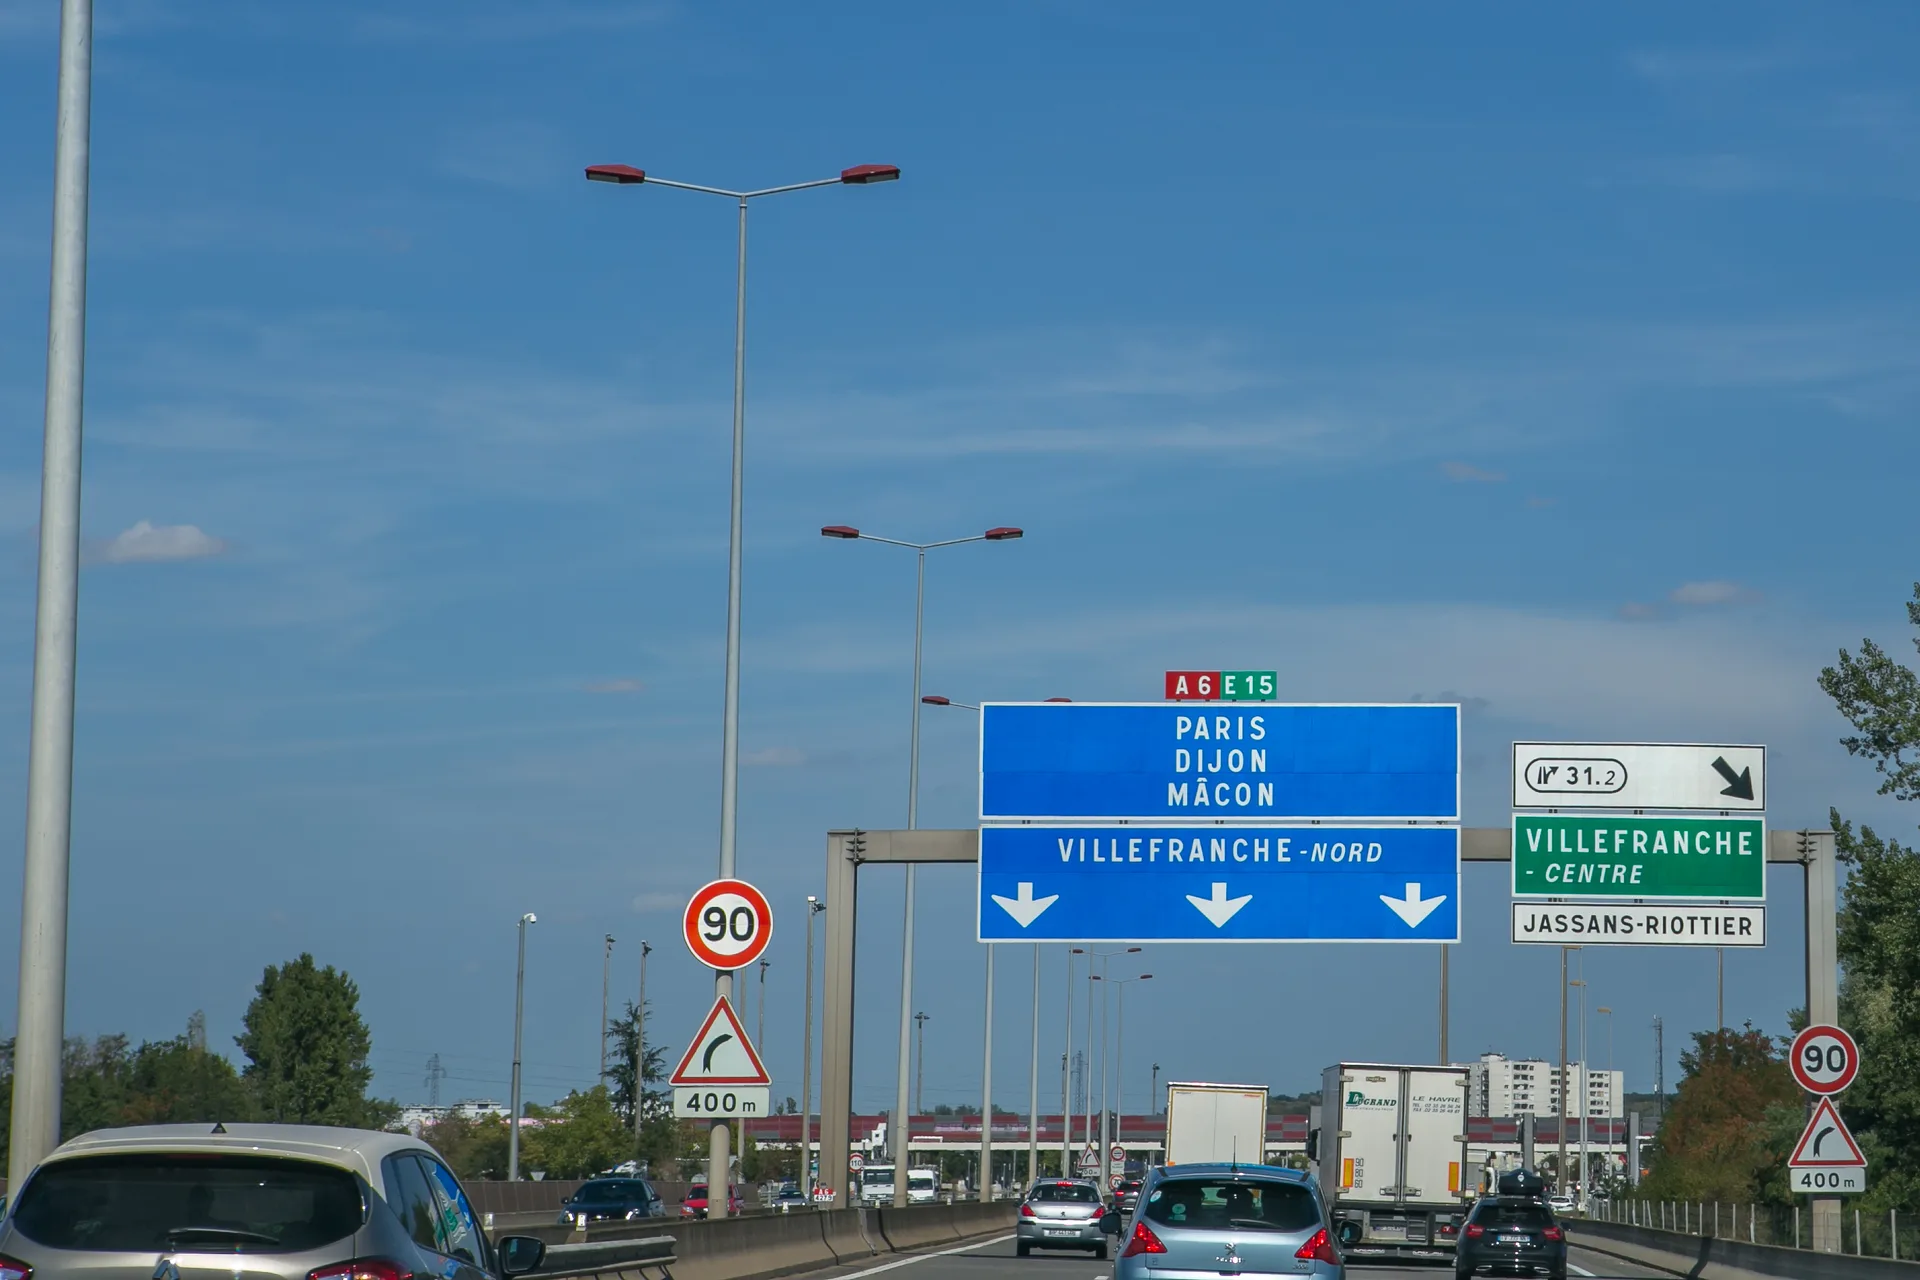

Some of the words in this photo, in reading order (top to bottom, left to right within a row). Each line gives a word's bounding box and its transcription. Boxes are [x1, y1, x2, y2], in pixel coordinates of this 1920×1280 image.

[1175, 675, 1189, 695] A
[1198, 675, 1211, 695] 6
[1225, 675, 1236, 695] E
[1245, 675, 1273, 695] 15
[1176, 716, 1266, 741] PARIS
[1175, 748, 1266, 773] DIJON
[1566, 766, 1616, 786] 31.2
[1168, 777, 1273, 807] MÂCON
[1525, 828, 1753, 856] VILLEFRANCHE
[1545, 863, 1644, 884] CENTRE
[703, 906, 755, 942] 90
[1523, 914, 1753, 936] JASSANS-RIOTTIER
[1804, 1045, 1846, 1073] 90
[686, 1092, 737, 1113] 400
[742, 1099, 756, 1112] m
[1428, 1096, 1461, 1104] HAVRE
[1800, 1172, 1840, 1188] 400
[1843, 1179, 1855, 1188] m
